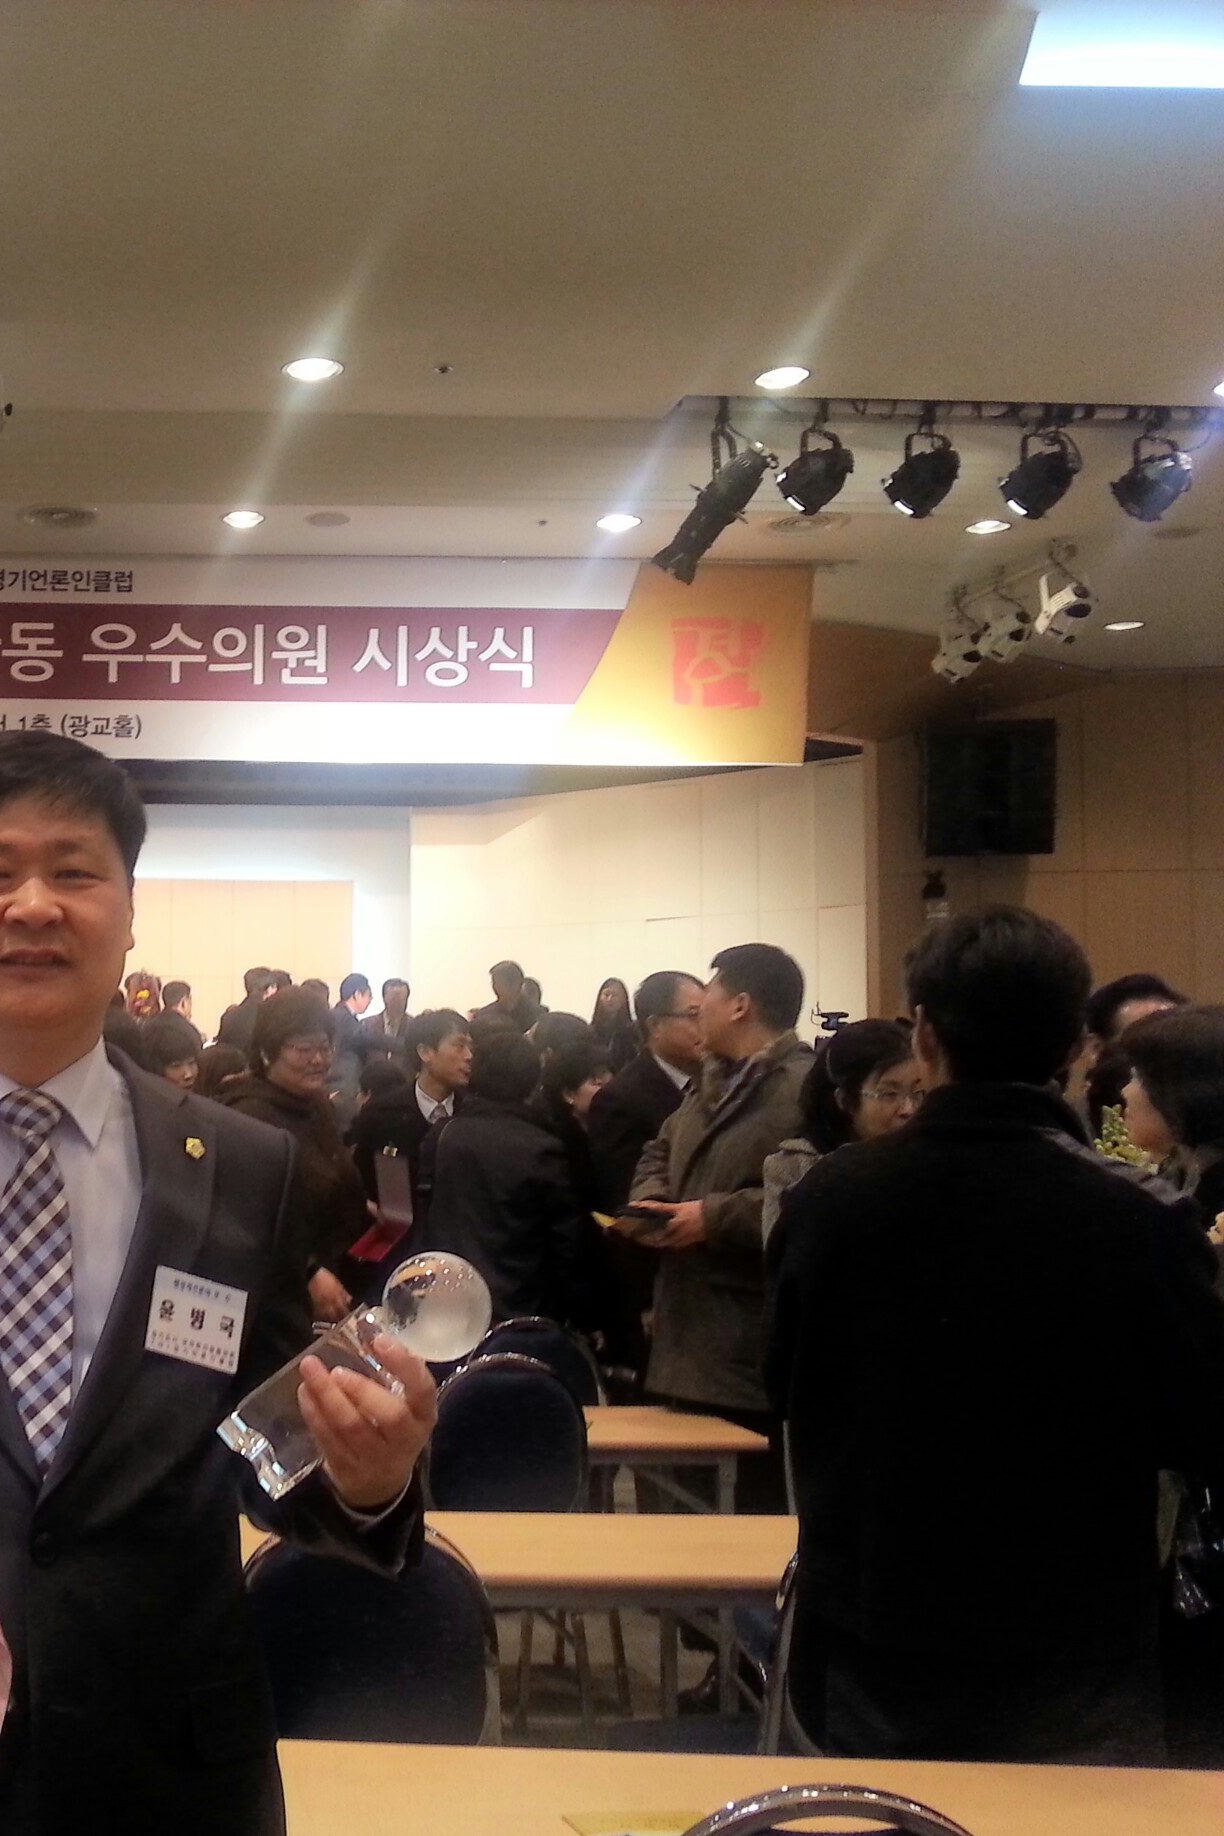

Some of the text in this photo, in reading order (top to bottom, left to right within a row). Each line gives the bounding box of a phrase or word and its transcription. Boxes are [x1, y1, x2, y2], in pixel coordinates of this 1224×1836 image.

[81, 622, 330, 686] 우수의원
[352, 625, 536, 689] 시상식
[60, 713, 143, 738] (광교홀)
